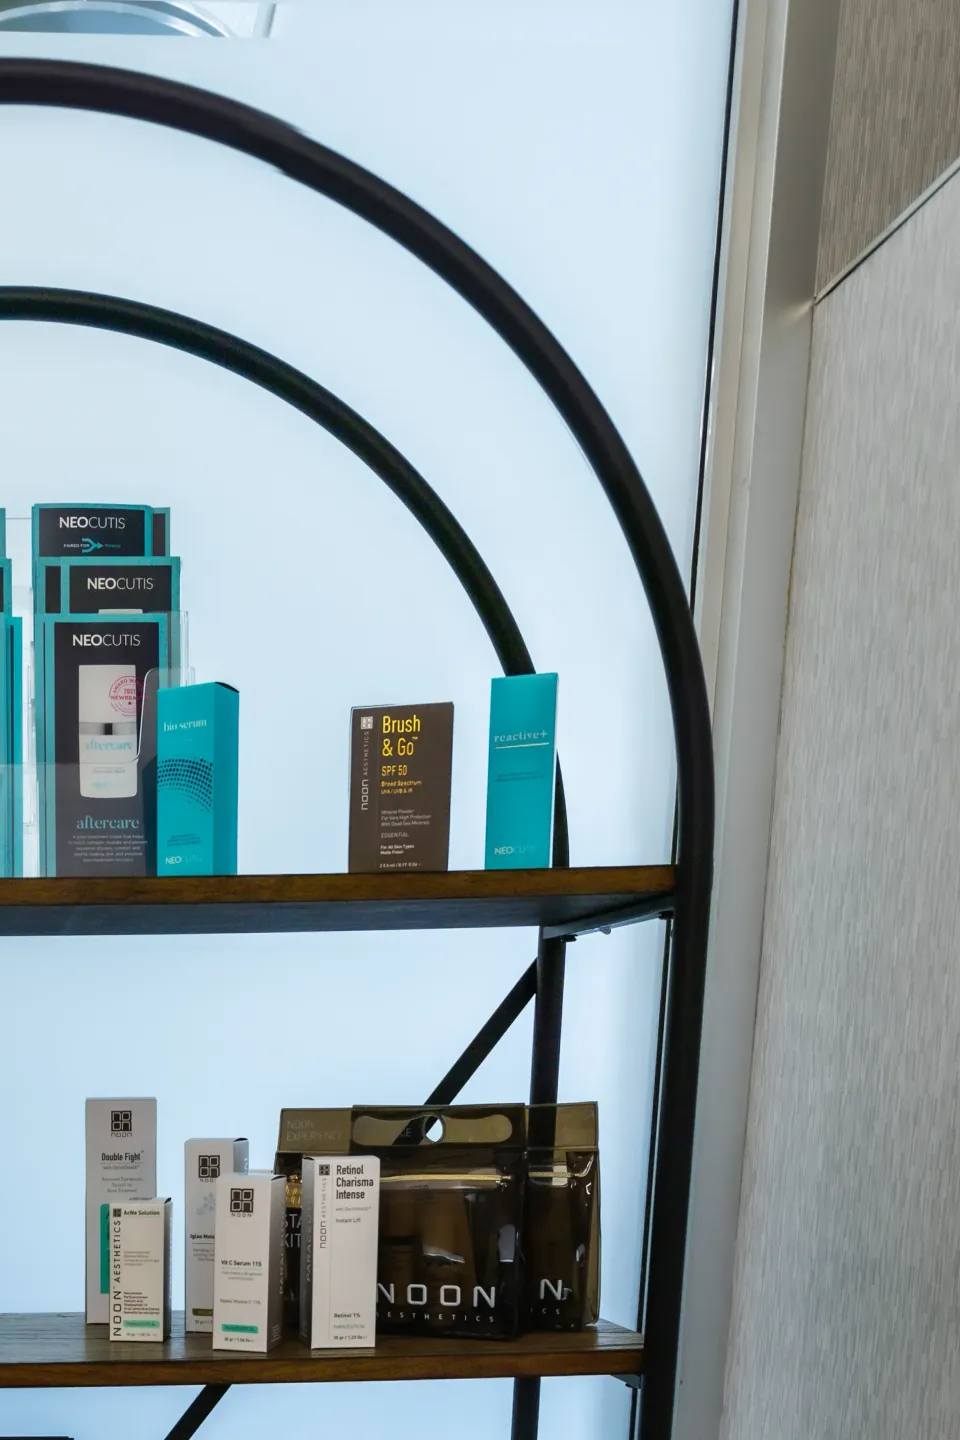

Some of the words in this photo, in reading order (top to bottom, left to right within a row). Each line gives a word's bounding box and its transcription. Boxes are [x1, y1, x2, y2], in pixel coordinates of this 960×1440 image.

[59, 516, 126, 529] NEOCUTIS
[87, 577, 154, 590] NEOCUTIS
[72, 634, 140, 647] NEOCUTIS
[164, 722, 177, 732] bio
[180, 719, 207, 729] serum
[382, 714, 420, 734] Brush
[382, 738, 393, 756] &
[382, 765, 396, 777] SPF
[398, 765, 408, 776] 50
[76, 815, 140, 829] aftercare
[101, 1153, 123, 1161] Double
[125, 1152, 140, 1162] Fight
[336, 1165, 364, 1175] Retinol
[336, 1177, 374, 1187] Charisma
[336, 1190, 365, 1200] Intense
[377, 1283, 495, 1308] NOON
[113, 1290, 122, 1337] NOON
